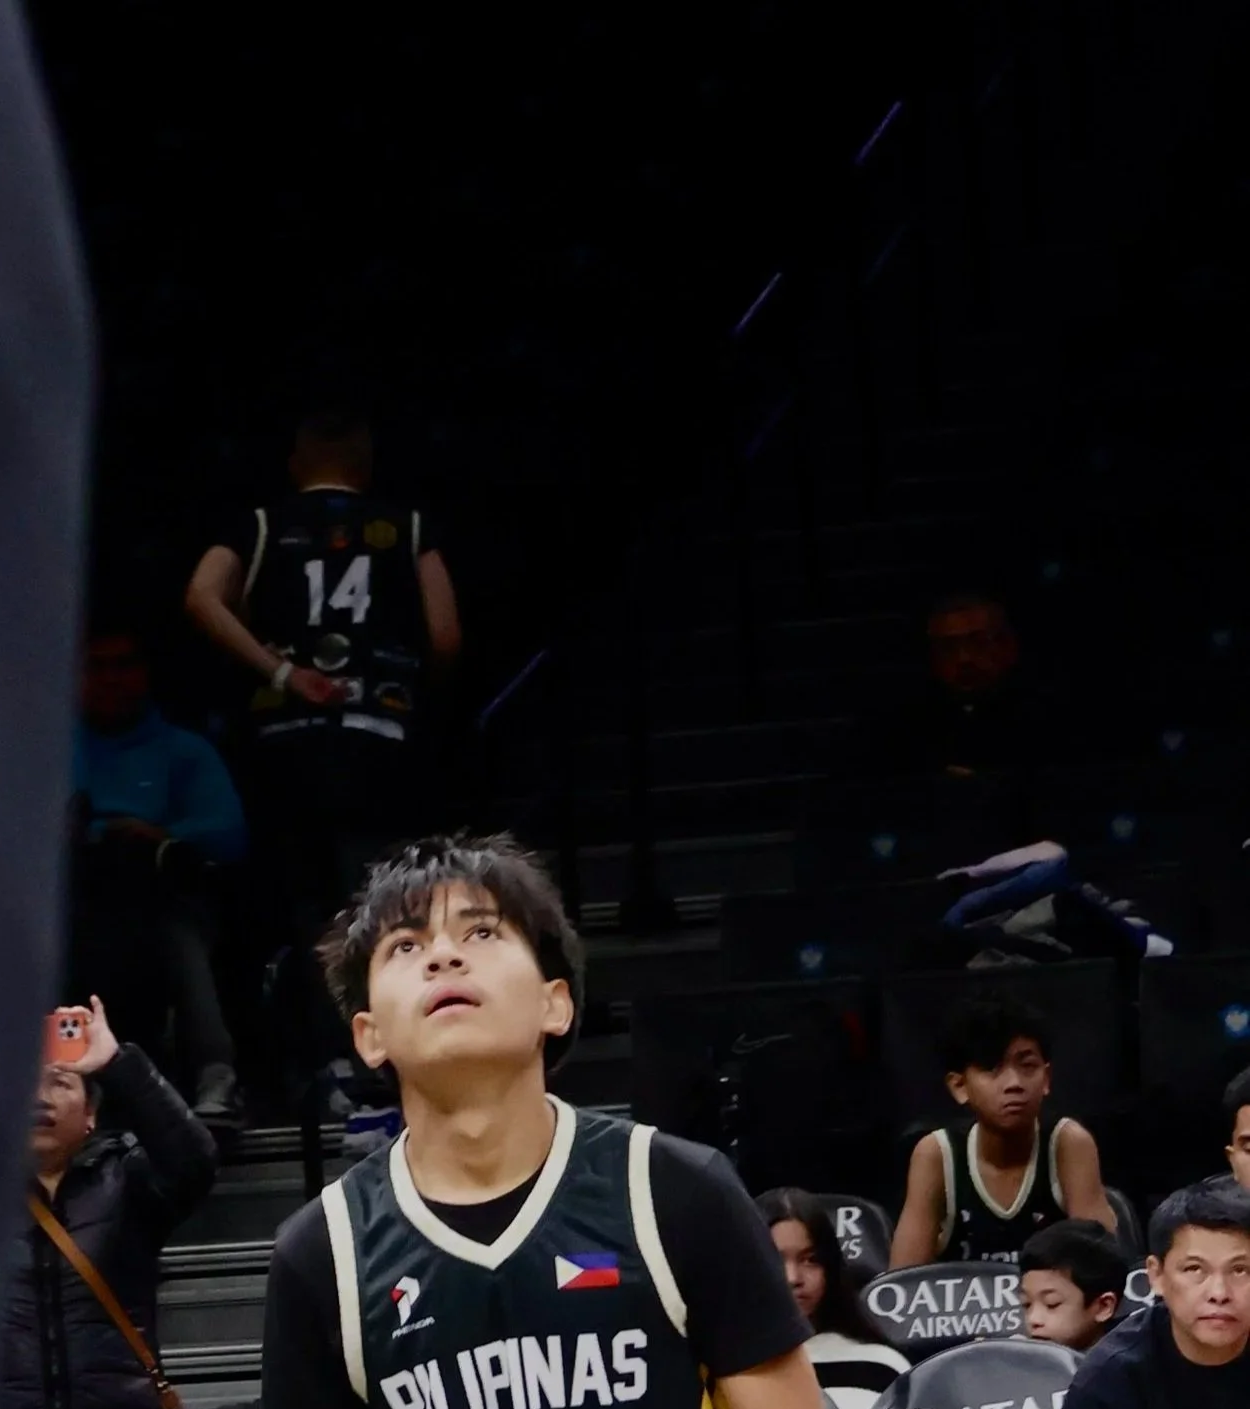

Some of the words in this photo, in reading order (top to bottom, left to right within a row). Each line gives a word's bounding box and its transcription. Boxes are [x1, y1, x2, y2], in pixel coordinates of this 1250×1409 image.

[304, 554, 372, 627] 14
[866, 1274, 1021, 1324] QATAR
[906, 1308, 1022, 1339] AIRWAYS
